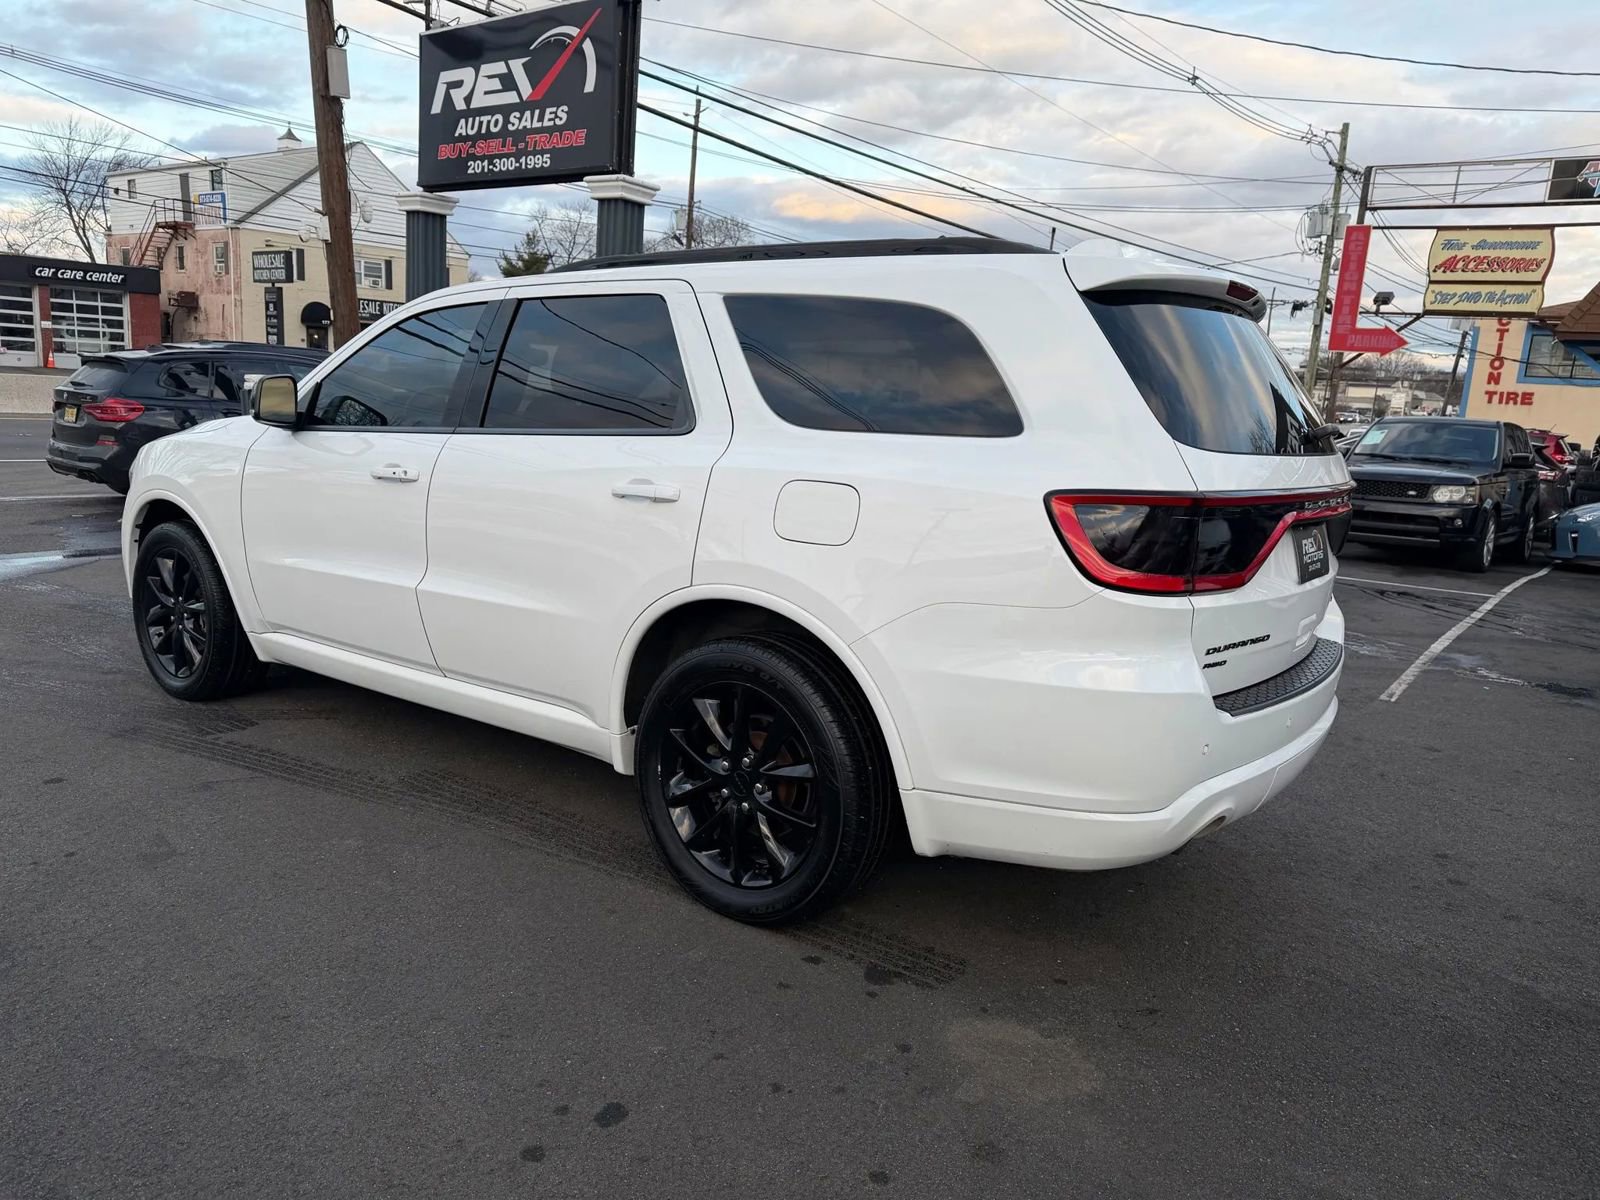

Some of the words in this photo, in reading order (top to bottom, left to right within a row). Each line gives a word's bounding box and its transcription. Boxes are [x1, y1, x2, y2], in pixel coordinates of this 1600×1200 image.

[454, 114, 502, 137] AUTO
[507, 105, 568, 131] SALES
[467, 154, 551, 174] 201-300-1995
[253, 253, 285, 269] WHOLESALE
[1432, 254, 1546, 273] ACCESSORIES
[35, 267, 55, 277] car
[57, 268, 83, 280] care
[85, 271, 124, 283] center
[271, 268, 286, 280] CENTER
[1347, 335, 1398, 347] PARKING
[1484, 390, 1535, 405] TIRE
[1303, 550, 1324, 564] MOTORS
[1205, 633, 1271, 656] DURANGO
